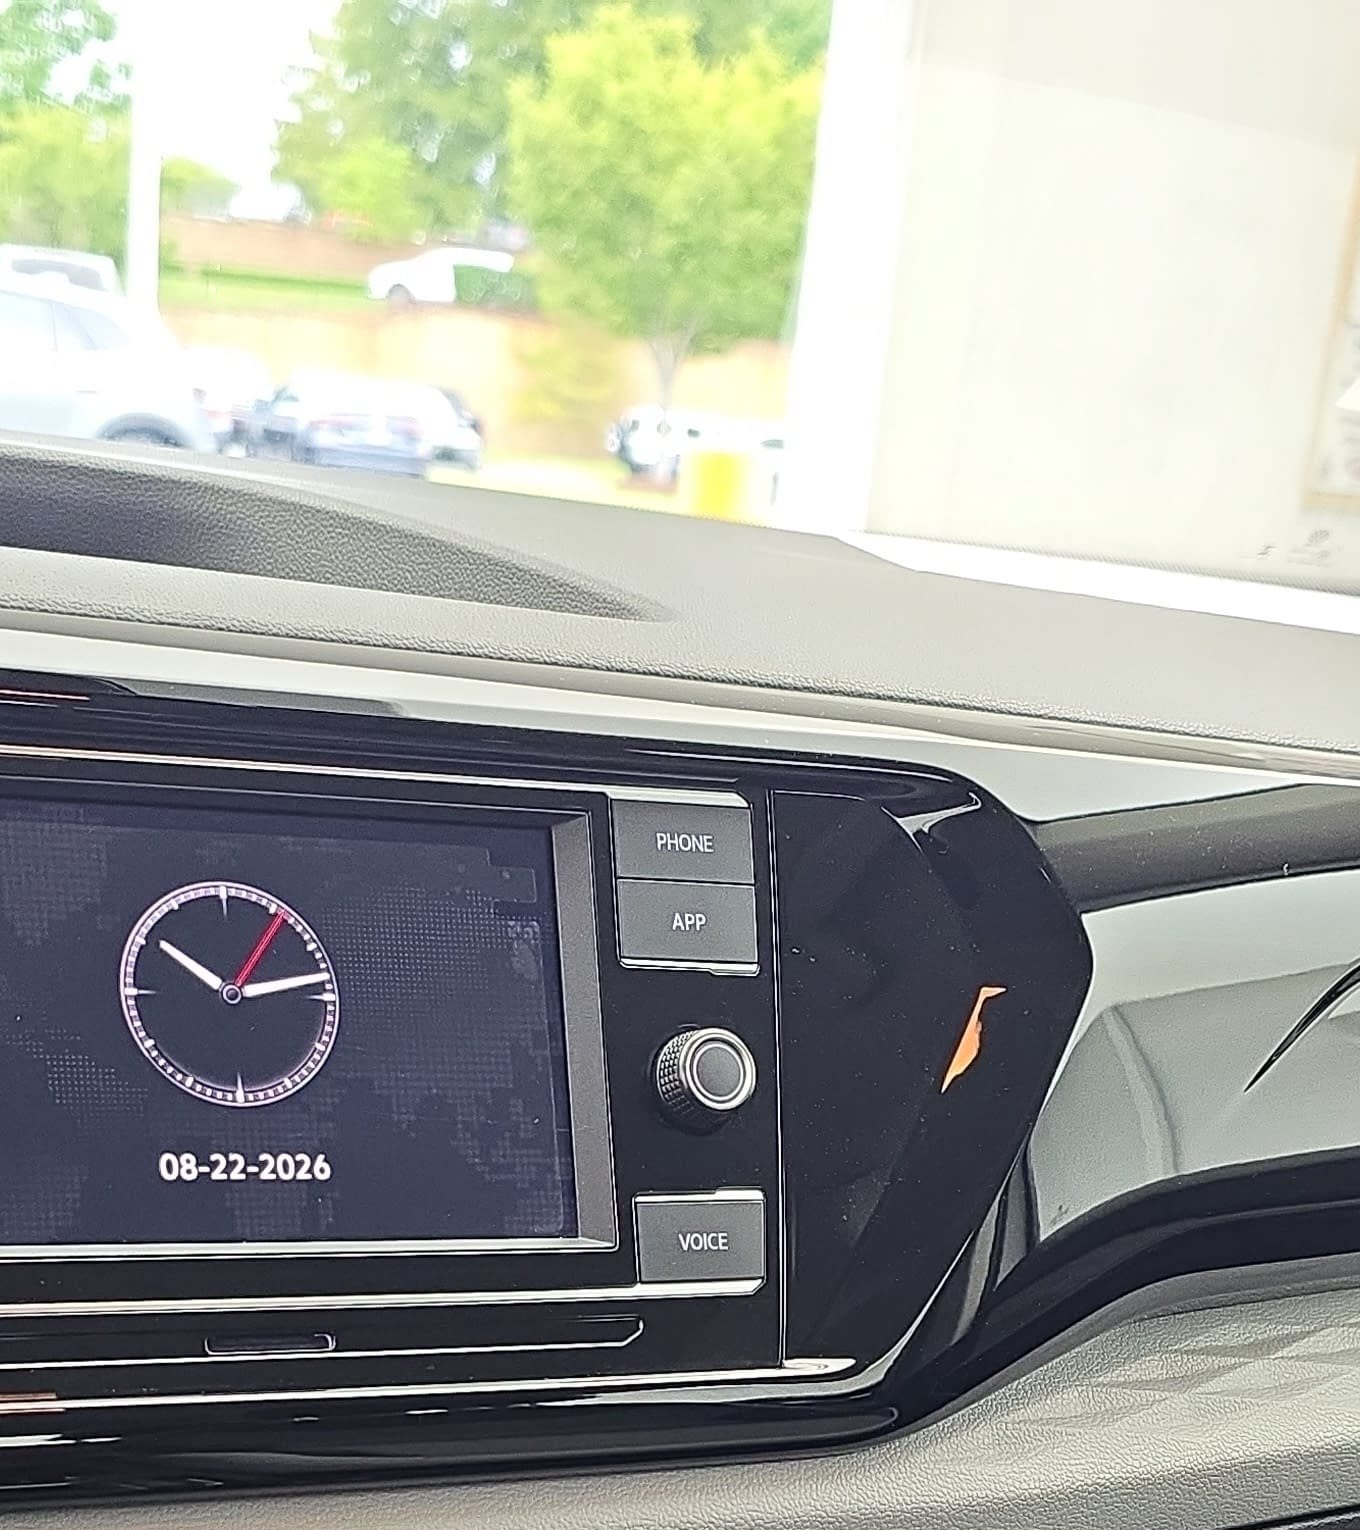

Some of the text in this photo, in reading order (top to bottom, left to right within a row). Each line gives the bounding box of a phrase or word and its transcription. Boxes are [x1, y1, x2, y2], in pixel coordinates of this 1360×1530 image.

[656, 831, 715, 854] PHONE
[671, 912, 707, 933] APP
[159, 1152, 332, 1181] 08-22-2026
[678, 1231, 729, 1252] VOICE
